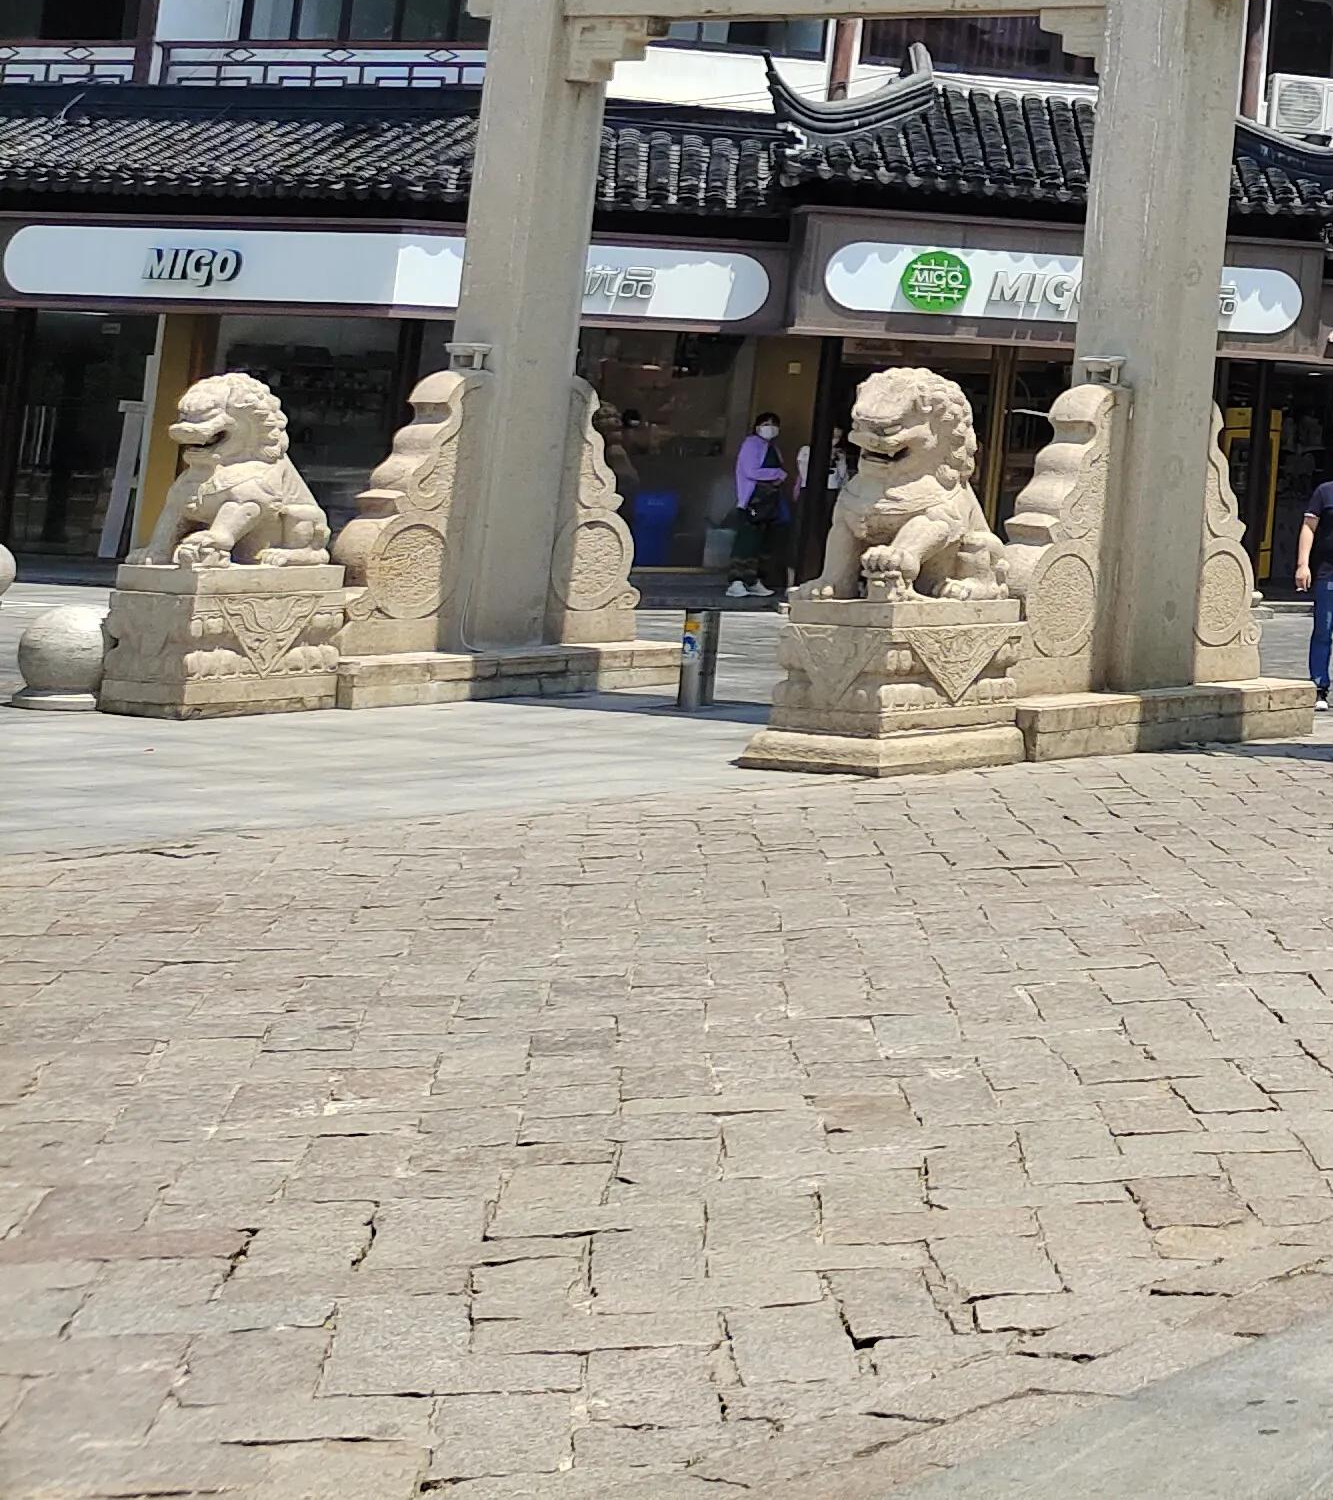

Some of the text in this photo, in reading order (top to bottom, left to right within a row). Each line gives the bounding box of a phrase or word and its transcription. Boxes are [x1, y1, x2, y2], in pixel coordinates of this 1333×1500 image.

[142, 247, 242, 288] MIGO
[910, 269, 963, 289] MIGO
[988, 270, 1082, 312] MIG
